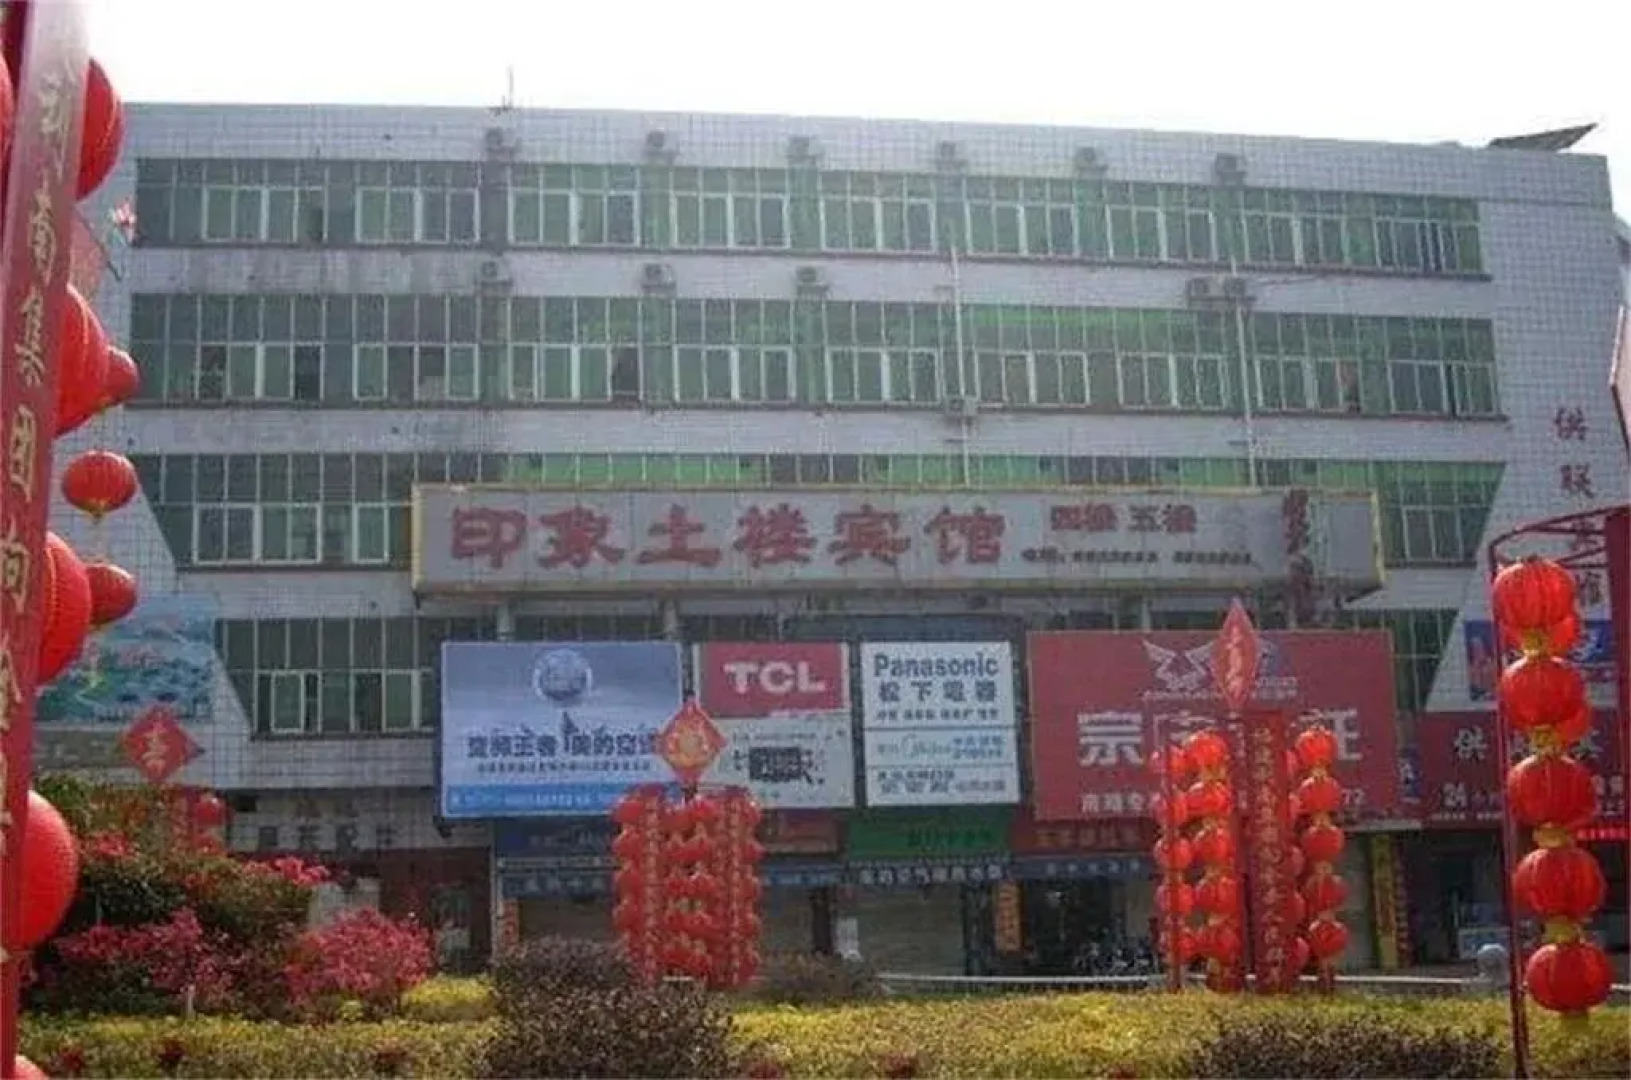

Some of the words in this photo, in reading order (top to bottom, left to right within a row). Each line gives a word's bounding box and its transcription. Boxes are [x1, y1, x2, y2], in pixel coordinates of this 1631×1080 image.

[450, 504, 1006, 569] 印象土楼宾馆
[724, 662, 827, 695] TCL
[873, 651, 999, 678] Panasonic
